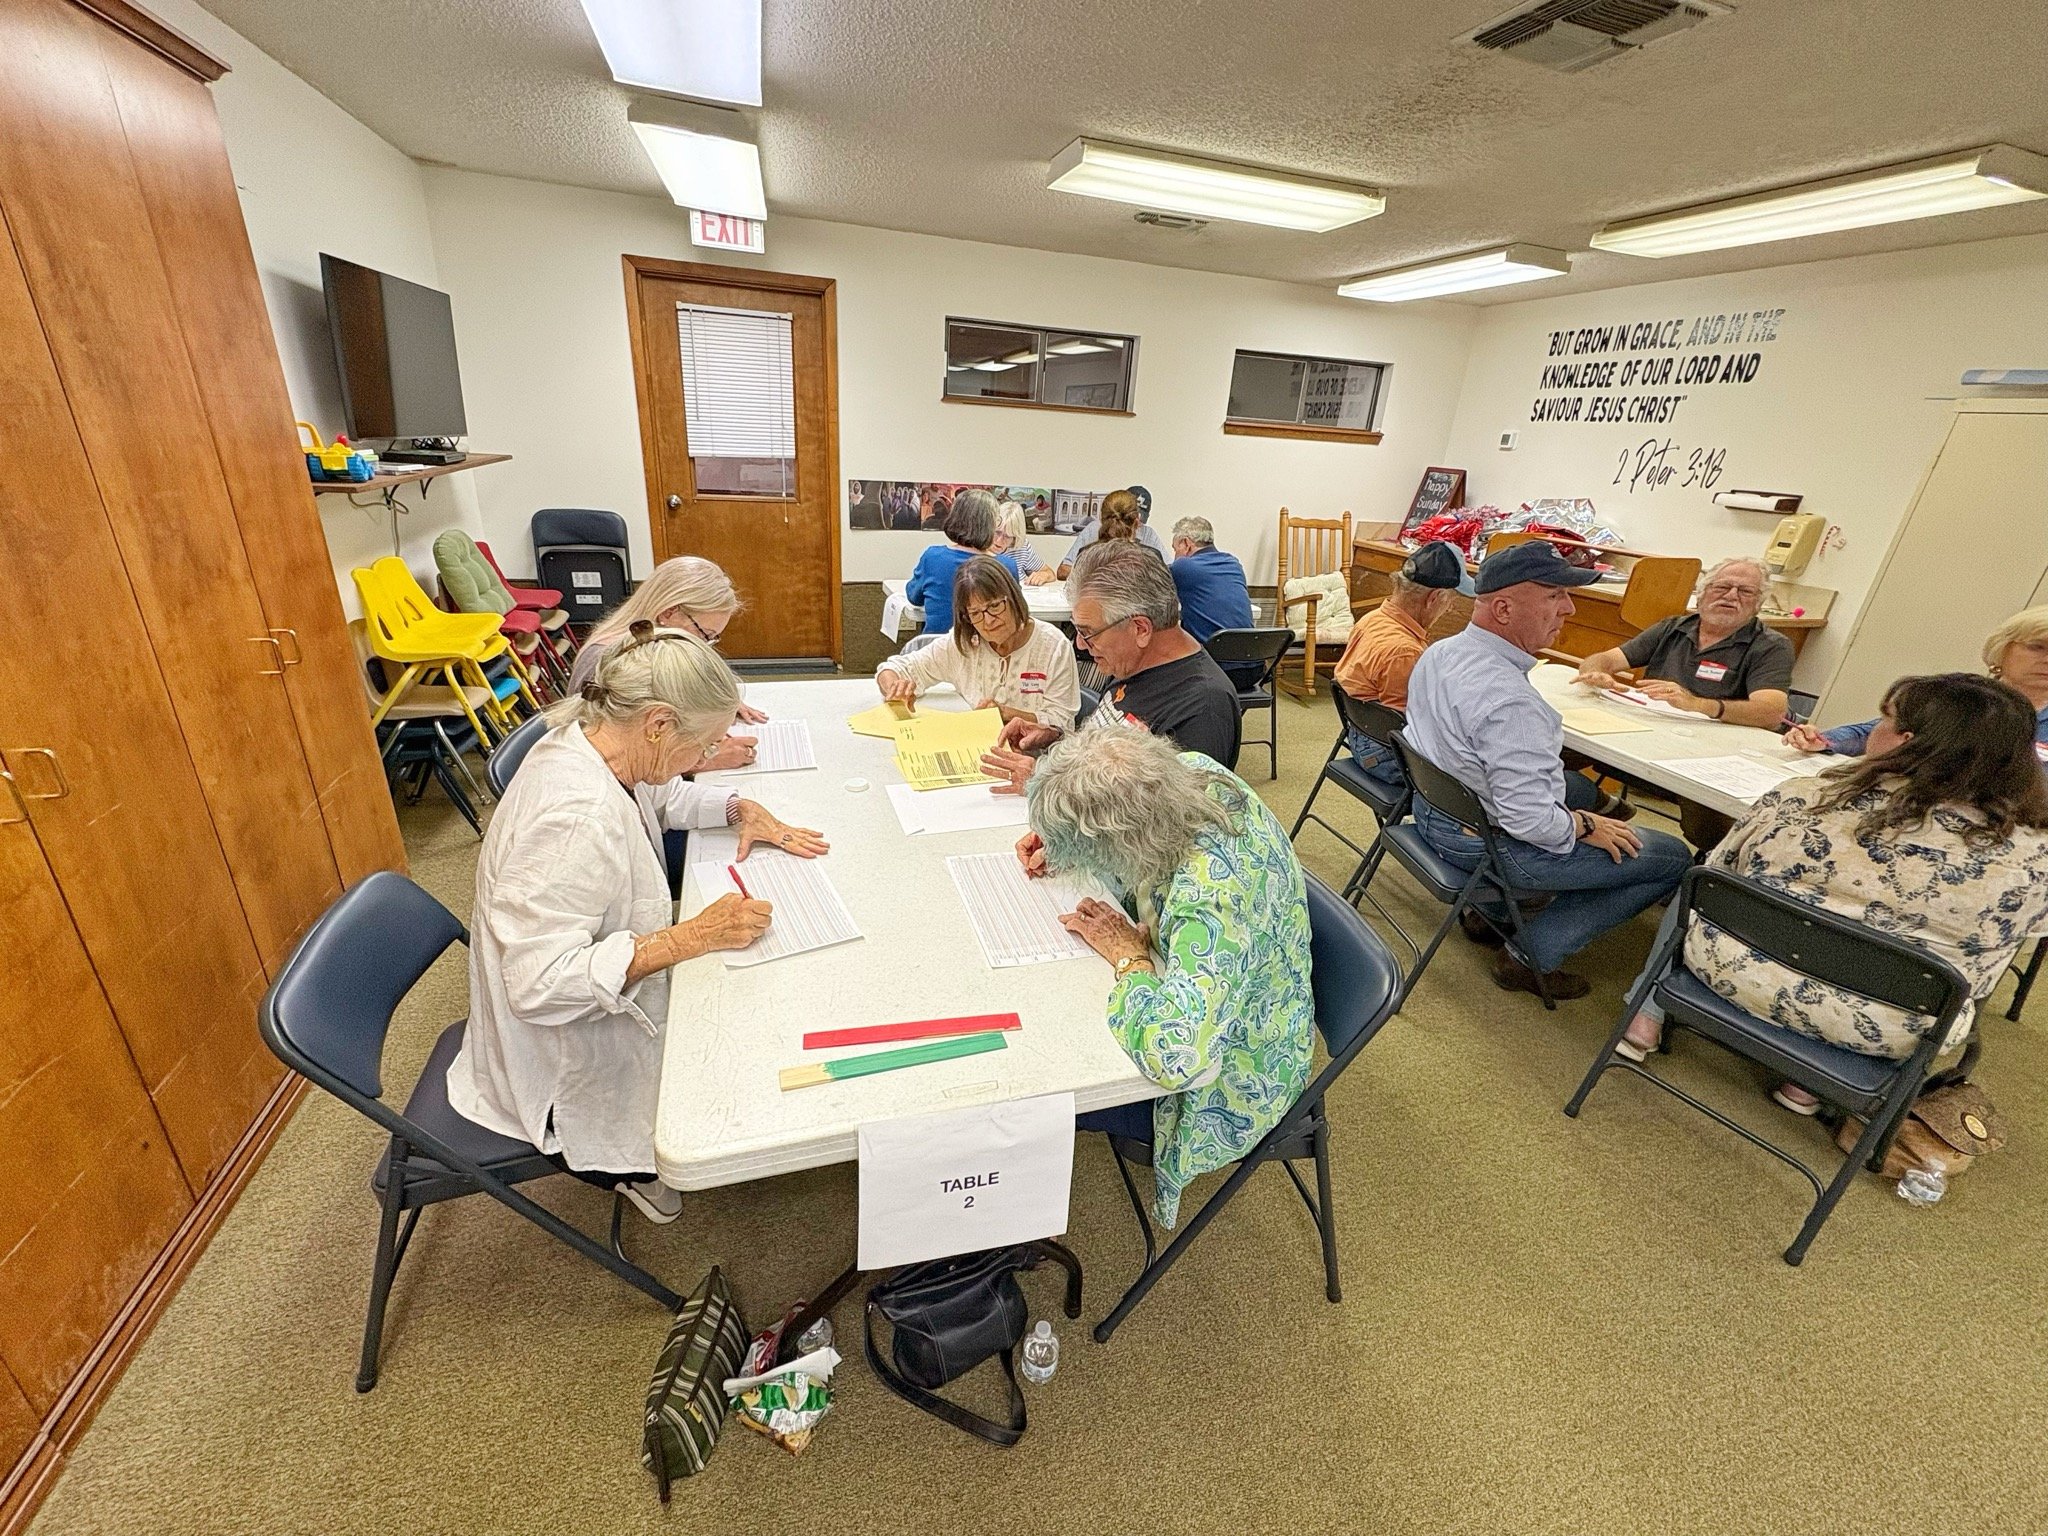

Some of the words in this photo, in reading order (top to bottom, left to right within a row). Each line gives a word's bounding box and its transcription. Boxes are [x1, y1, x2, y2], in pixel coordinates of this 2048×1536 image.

[700, 210, 749, 246] EXIT
[1573, 326, 1613, 355] GROW
[1612, 324, 1631, 351] IN
[1630, 319, 1683, 350] GRACE,
[1686, 314, 1726, 346] AND
[1723, 312, 1748, 344] IN
[1539, 361, 1618, 390] KNOWLEDGE
[1620, 359, 1642, 387] OF
[1641, 357, 1674, 386] OUR
[1675, 354, 1722, 385] LORD
[1719, 352, 1762, 384] AND
[1530, 396, 1583, 422] SAVIOUR
[1583, 396, 1627, 423] JESUS
[1630, 438, 1680, 494] Peter
[1681, 447, 1727, 489] 3:18
[940, 1171, 1000, 1193] TABLE
[963, 1196, 975, 1209] 2
